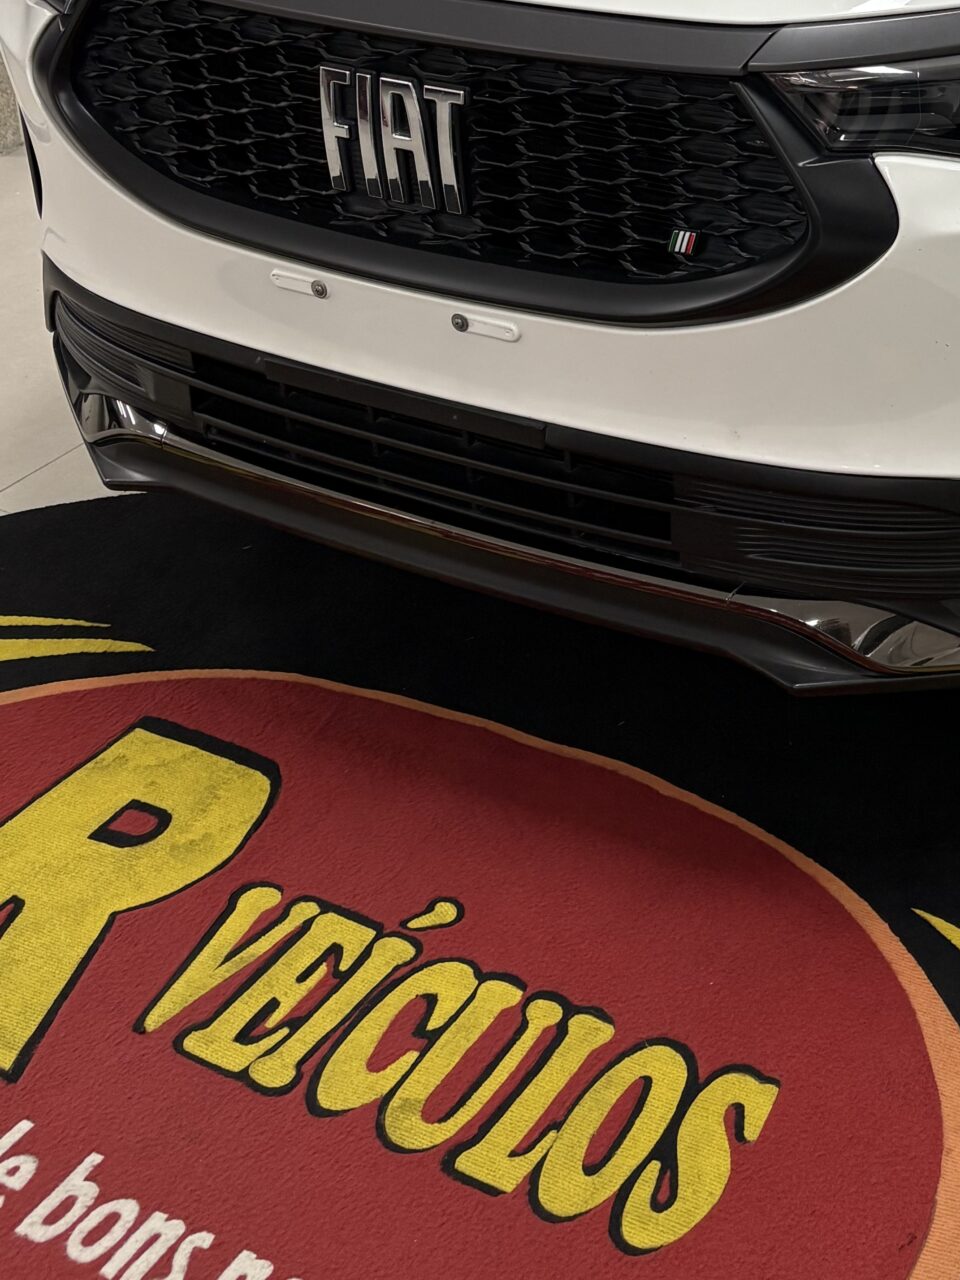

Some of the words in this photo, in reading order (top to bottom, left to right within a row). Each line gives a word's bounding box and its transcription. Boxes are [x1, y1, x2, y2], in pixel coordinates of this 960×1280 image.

[319, 65, 466, 216] FIAT
[131, 881, 781, 1257] VEÍCULOS
[13, 1151, 216, 1280] bons
